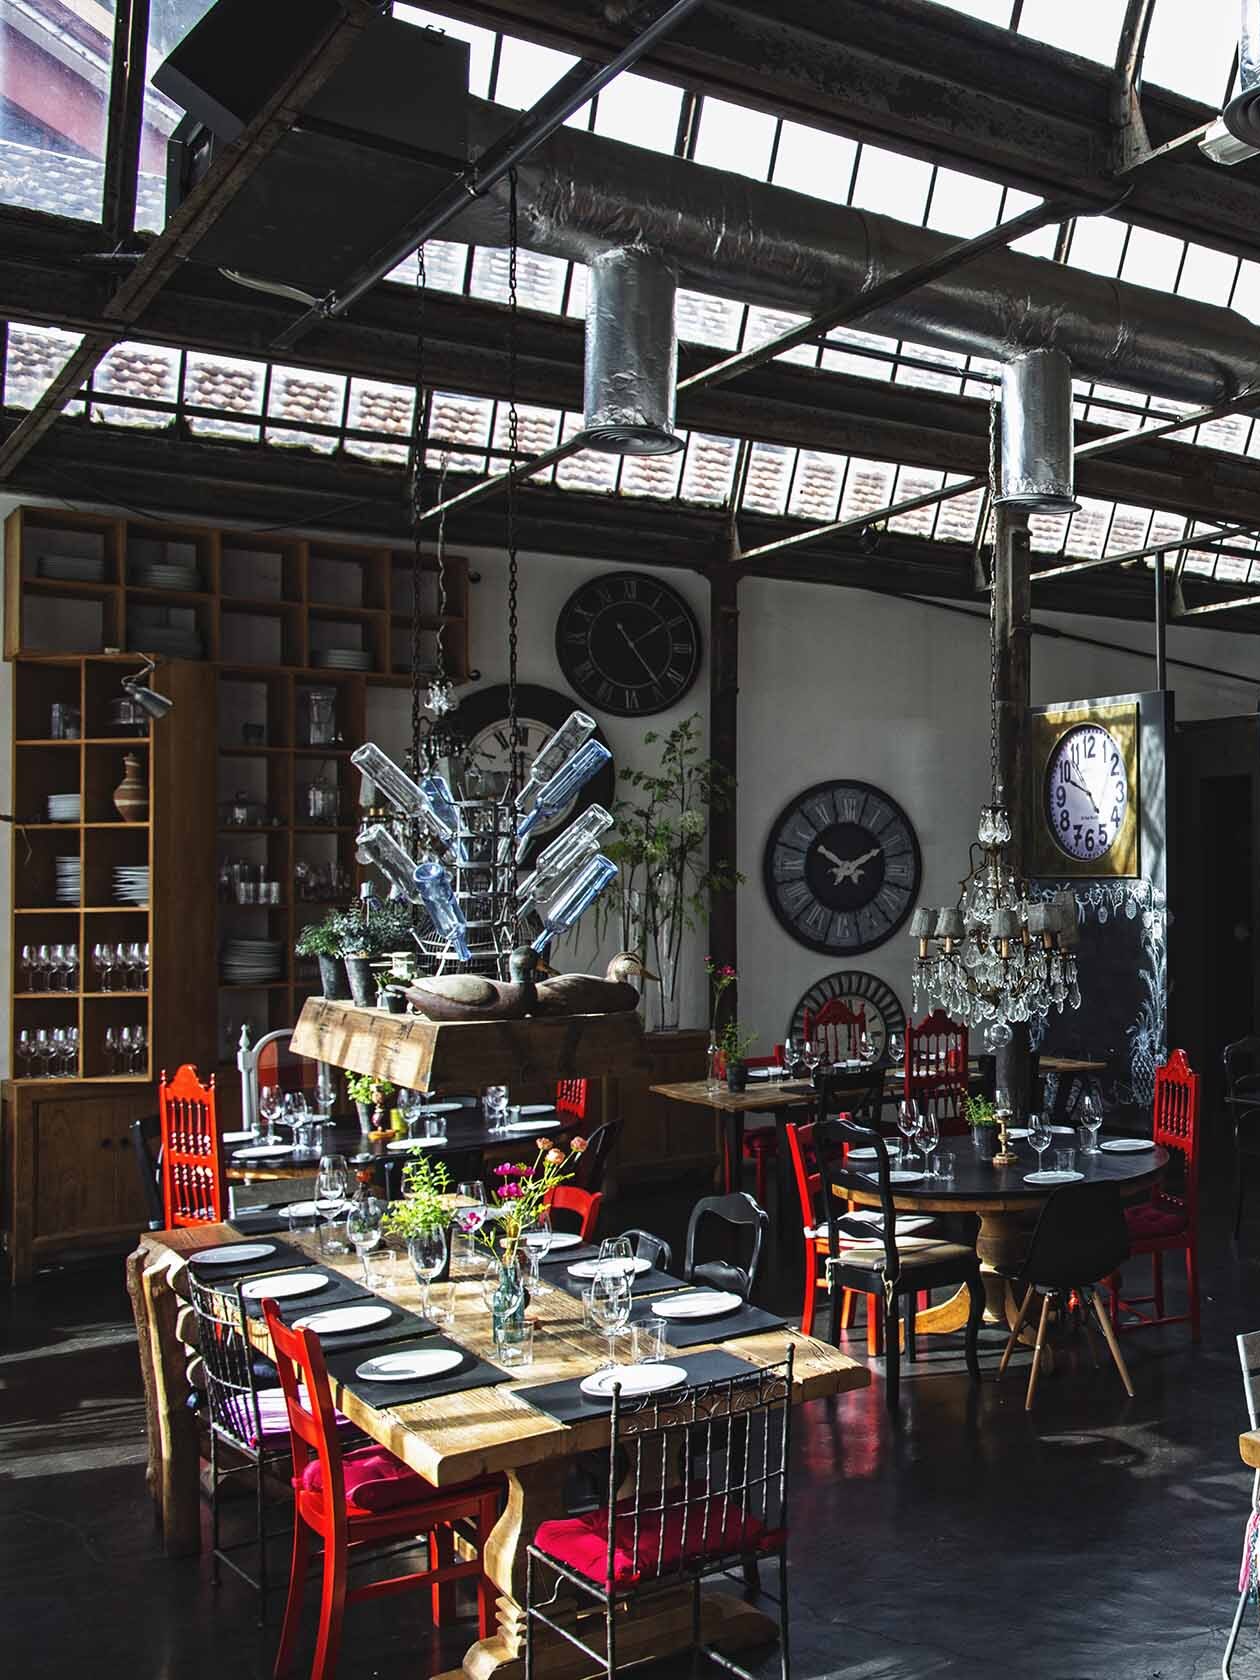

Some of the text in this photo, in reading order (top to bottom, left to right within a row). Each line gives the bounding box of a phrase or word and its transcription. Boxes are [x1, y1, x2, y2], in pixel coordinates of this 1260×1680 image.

[1071, 743, 1080, 765] 11
[1083, 735, 1096, 759] 12
[1103, 740, 1107, 763] 1
[1059, 759, 1071, 783] 10
[1110, 753, 1120, 777] 2
[1056, 785, 1066, 808] 9
[1115, 780, 1125, 804] 3
[1060, 809, 1070, 831] 8
[1110, 805, 1121, 828] 4
[1073, 824, 1083, 847] 7
[1085, 828, 1095, 851] 6
[1098, 823, 1108, 846] 5
